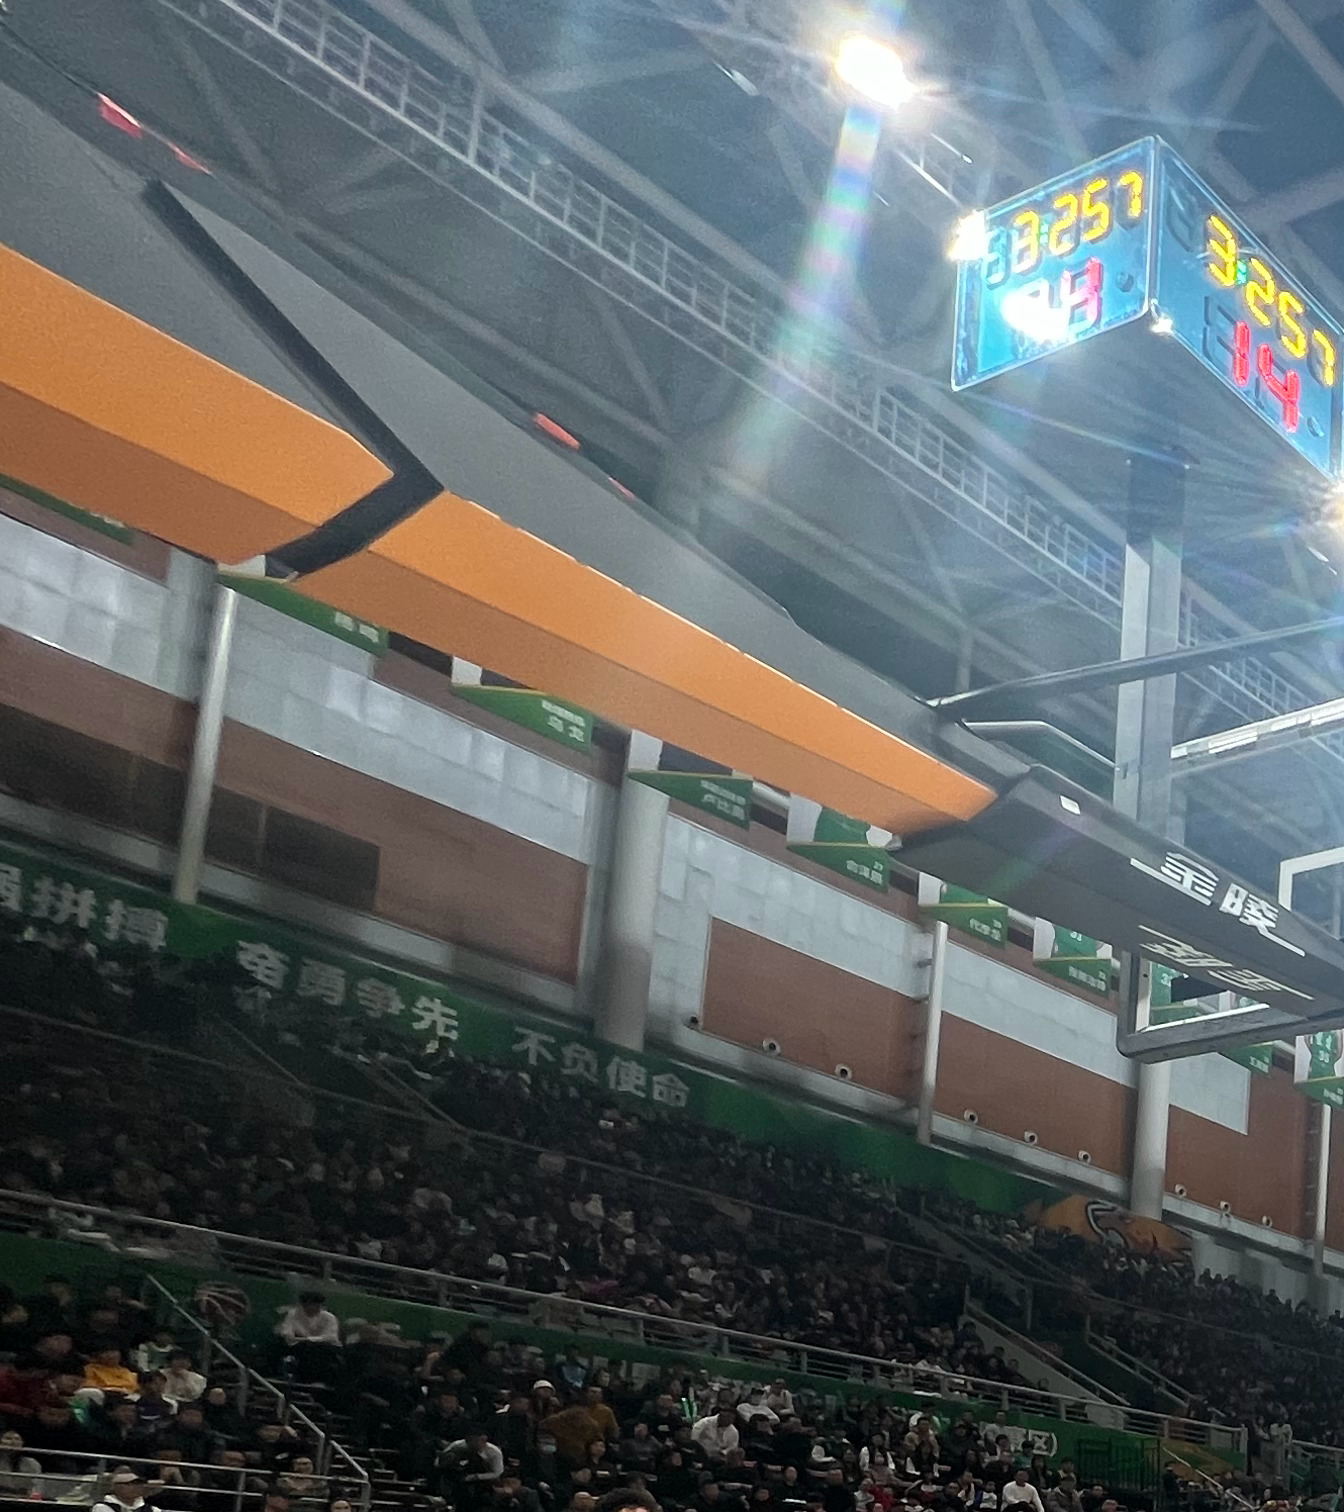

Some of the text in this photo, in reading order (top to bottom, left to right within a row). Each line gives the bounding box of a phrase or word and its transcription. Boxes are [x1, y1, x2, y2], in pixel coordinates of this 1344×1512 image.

[1232, 321, 1300, 433] 14
[510, 1026, 691, 1108] 不负使命
